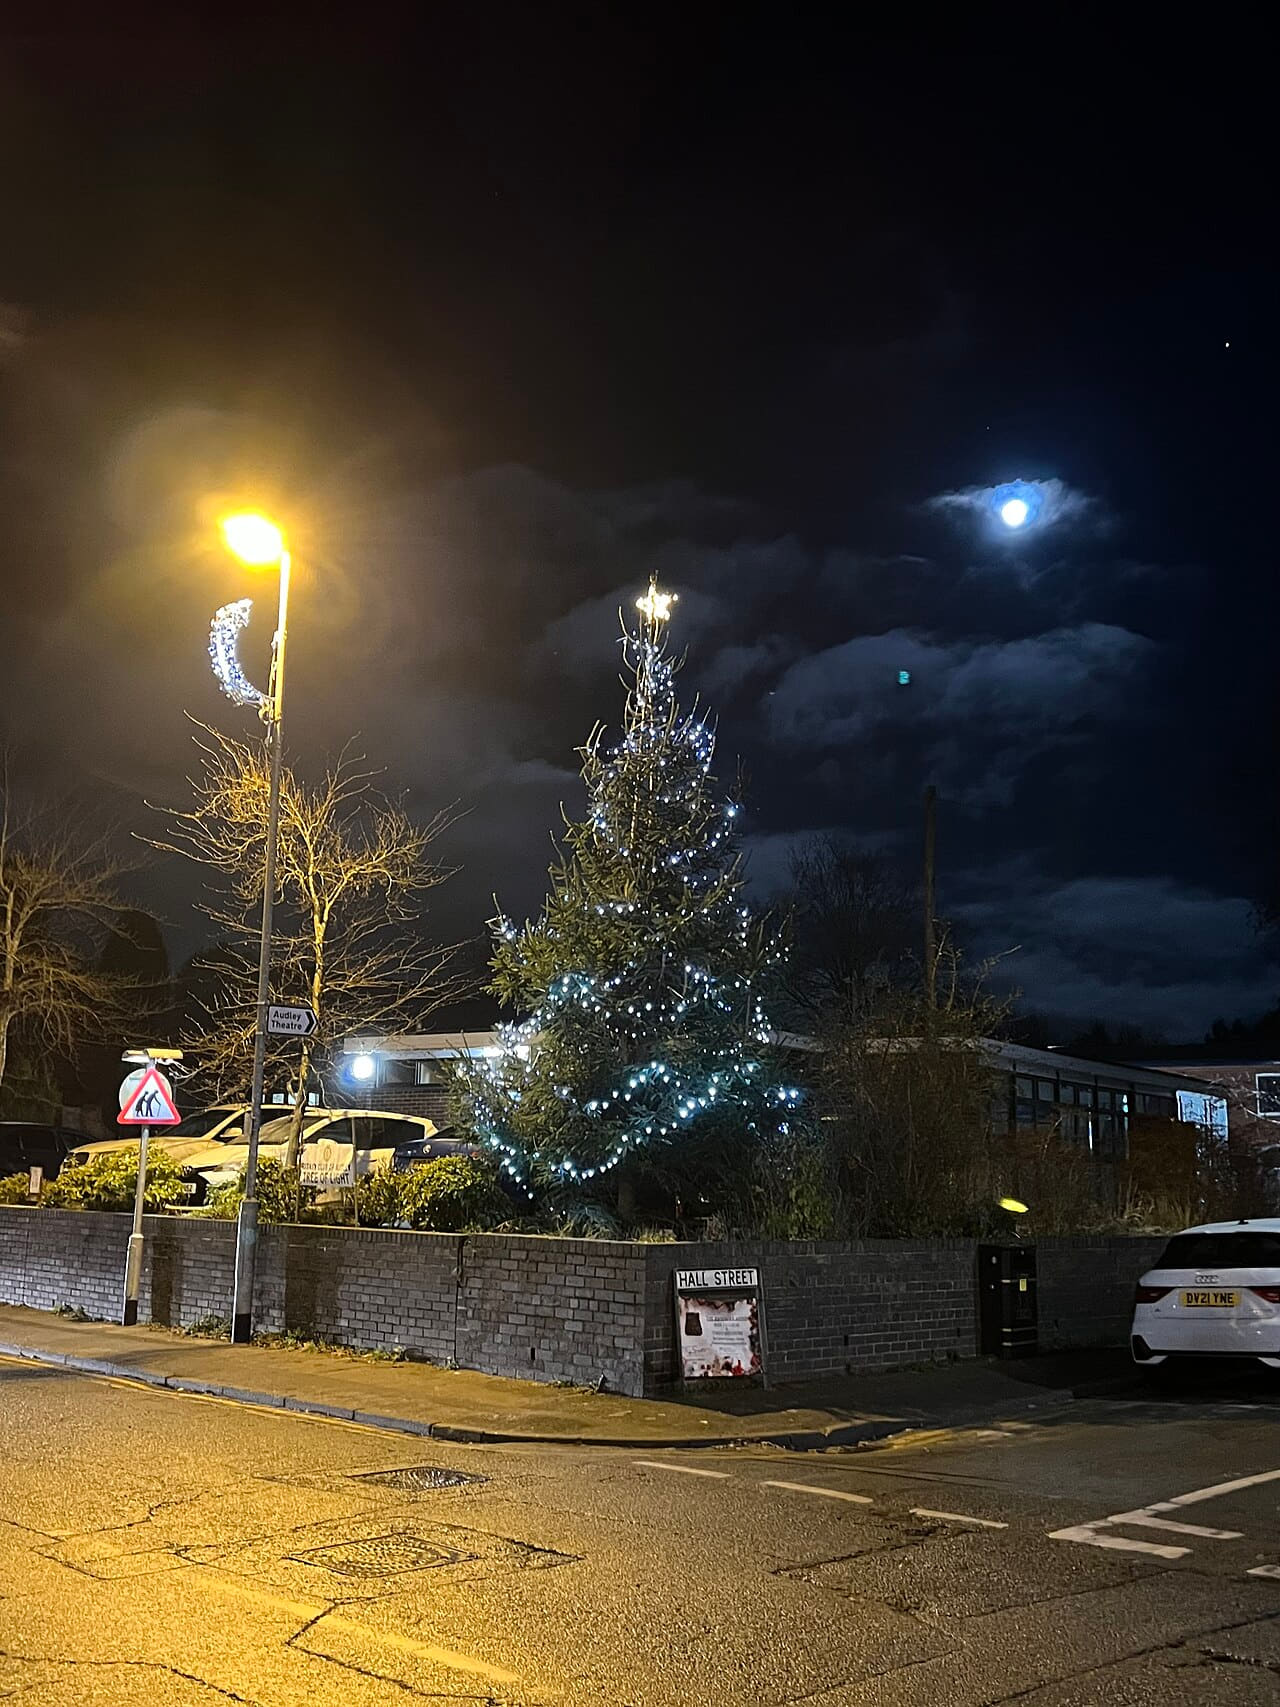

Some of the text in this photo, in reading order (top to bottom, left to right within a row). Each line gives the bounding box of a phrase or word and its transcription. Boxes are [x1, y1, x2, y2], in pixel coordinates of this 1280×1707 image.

[273, 1010, 301, 1021] Audley
[272, 1020, 302, 1030] Theatre
[303, 1171, 349, 1184] TREE OF LIGHT
[679, 1270, 754, 1287] HALL STREET
[1186, 1293, 1234, 1304] DV21 YNE
